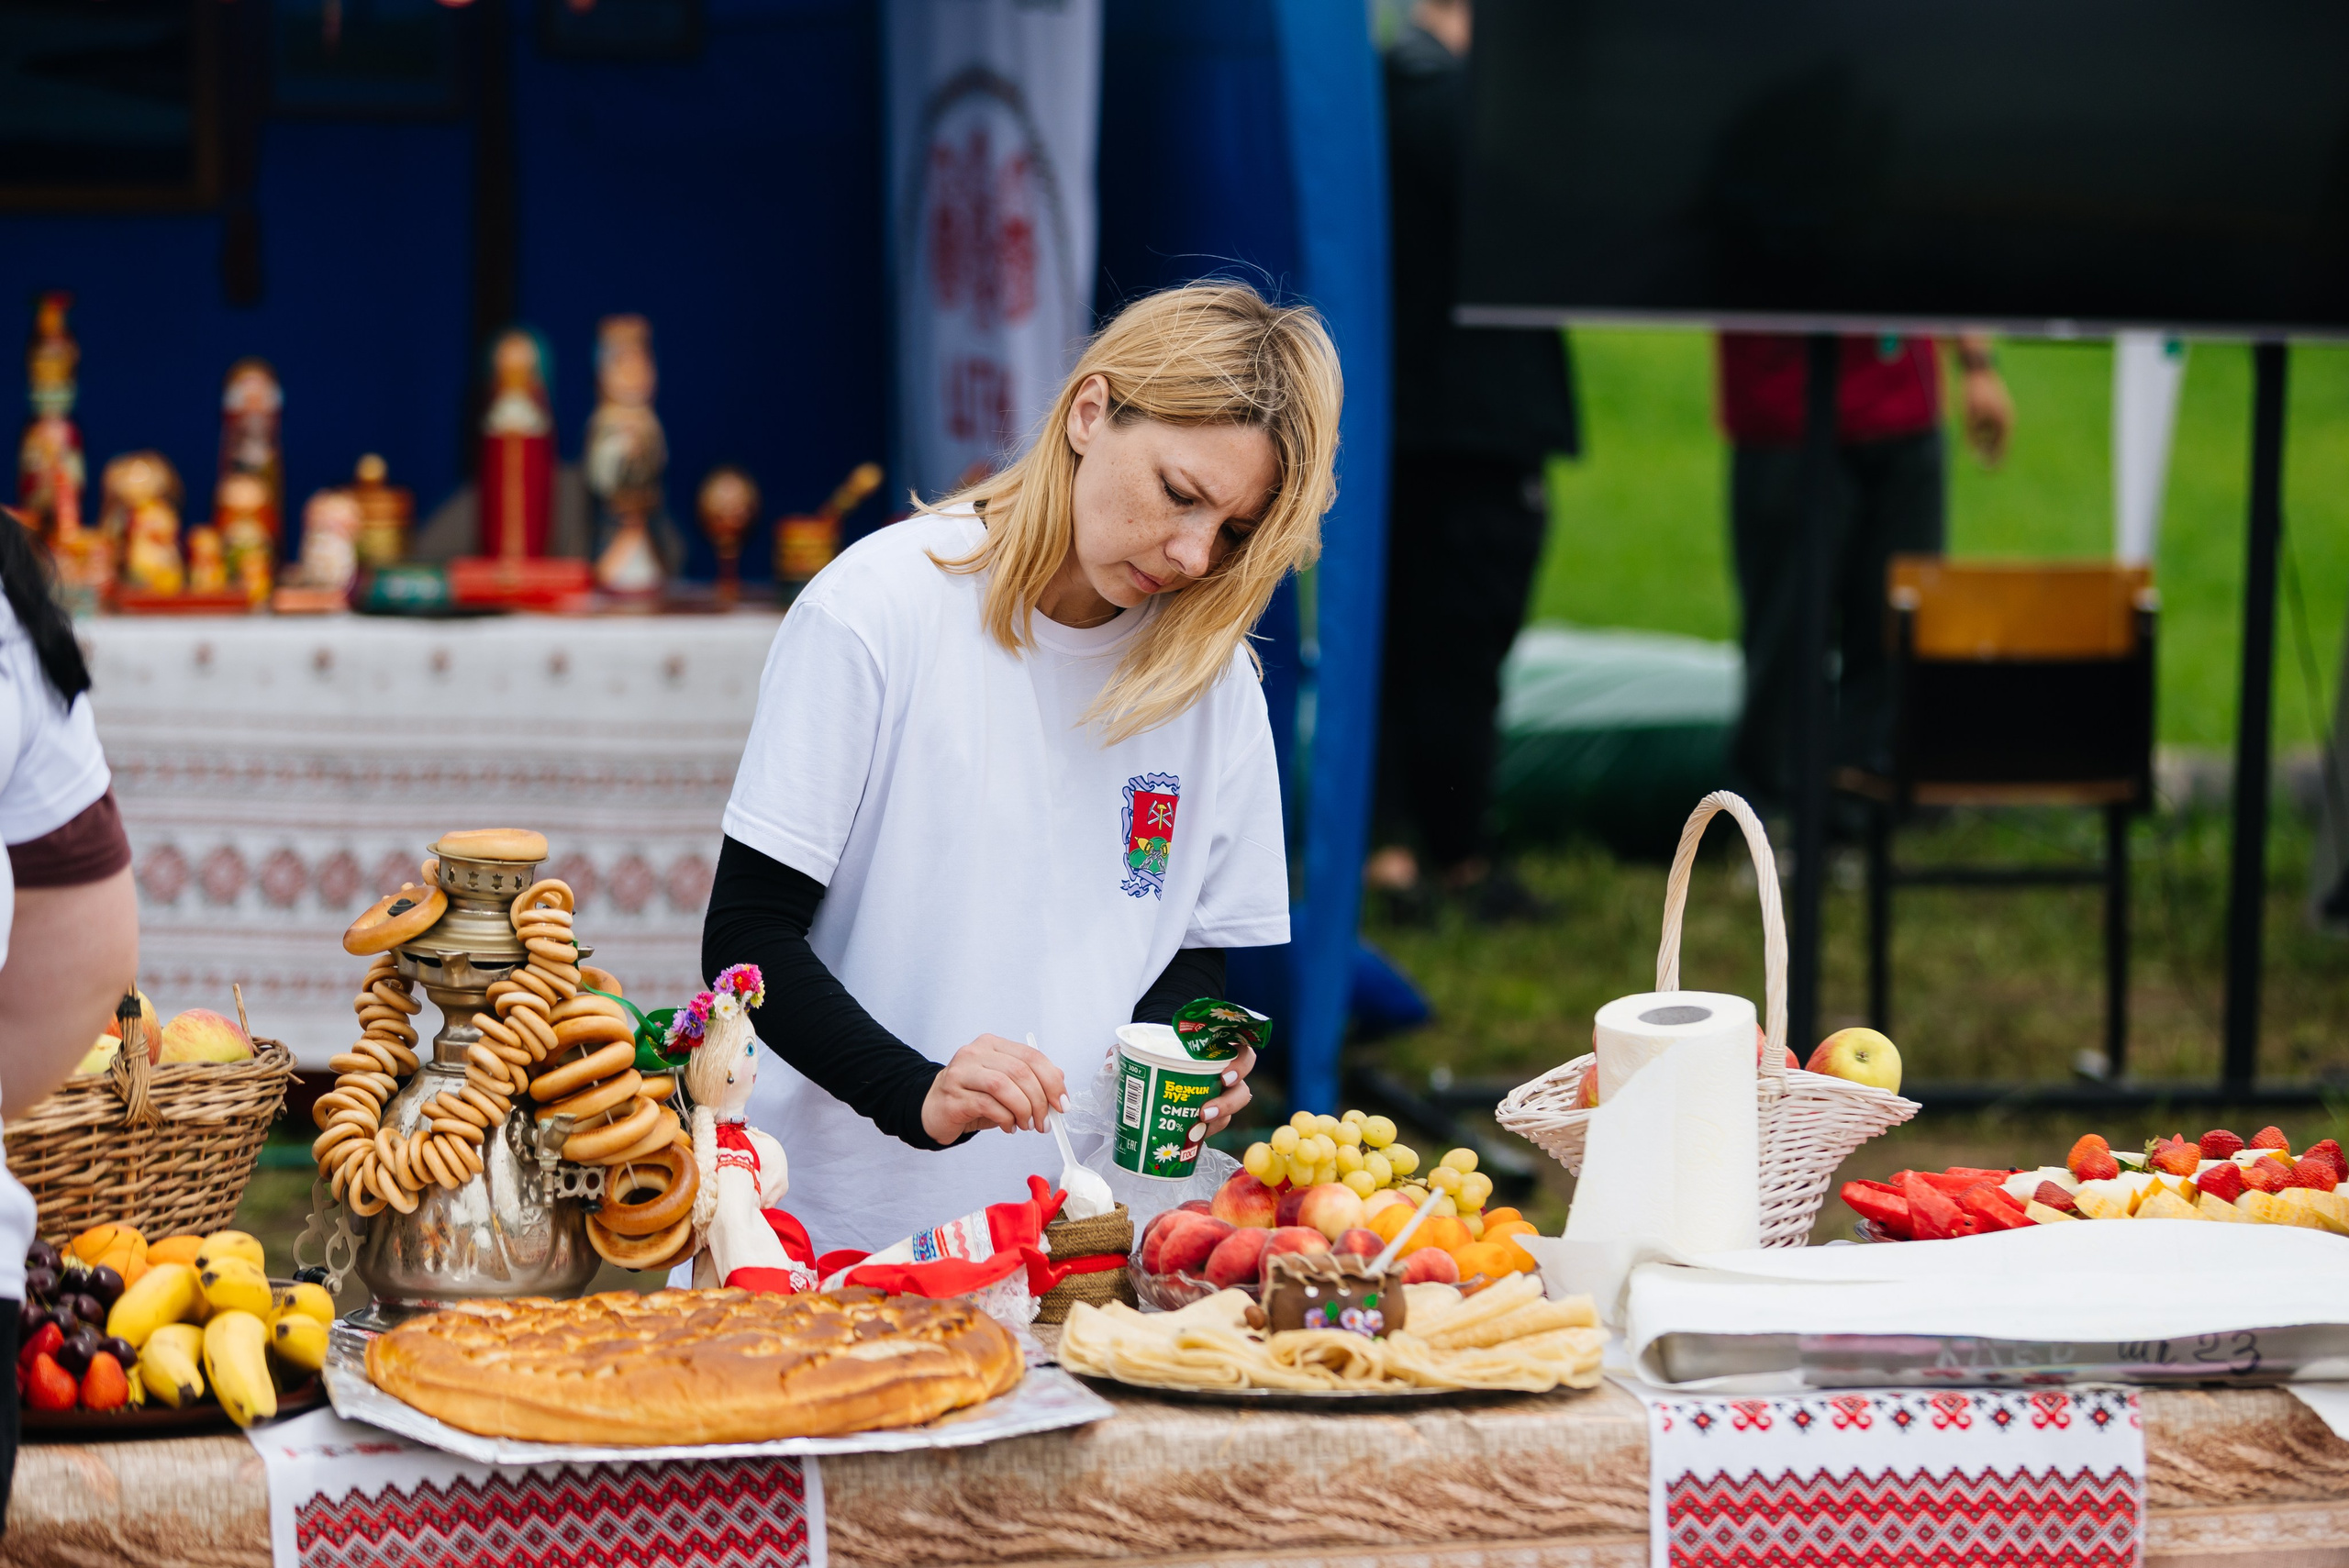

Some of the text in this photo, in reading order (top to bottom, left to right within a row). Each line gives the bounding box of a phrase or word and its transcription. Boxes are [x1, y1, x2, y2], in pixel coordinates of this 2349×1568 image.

[1128, 1064, 1138, 1073] 300
[1164, 1080, 1209, 1095] Бежин
[1158, 1118, 1184, 1132] 20%
[2192, 1329, 2263, 1376] 23
